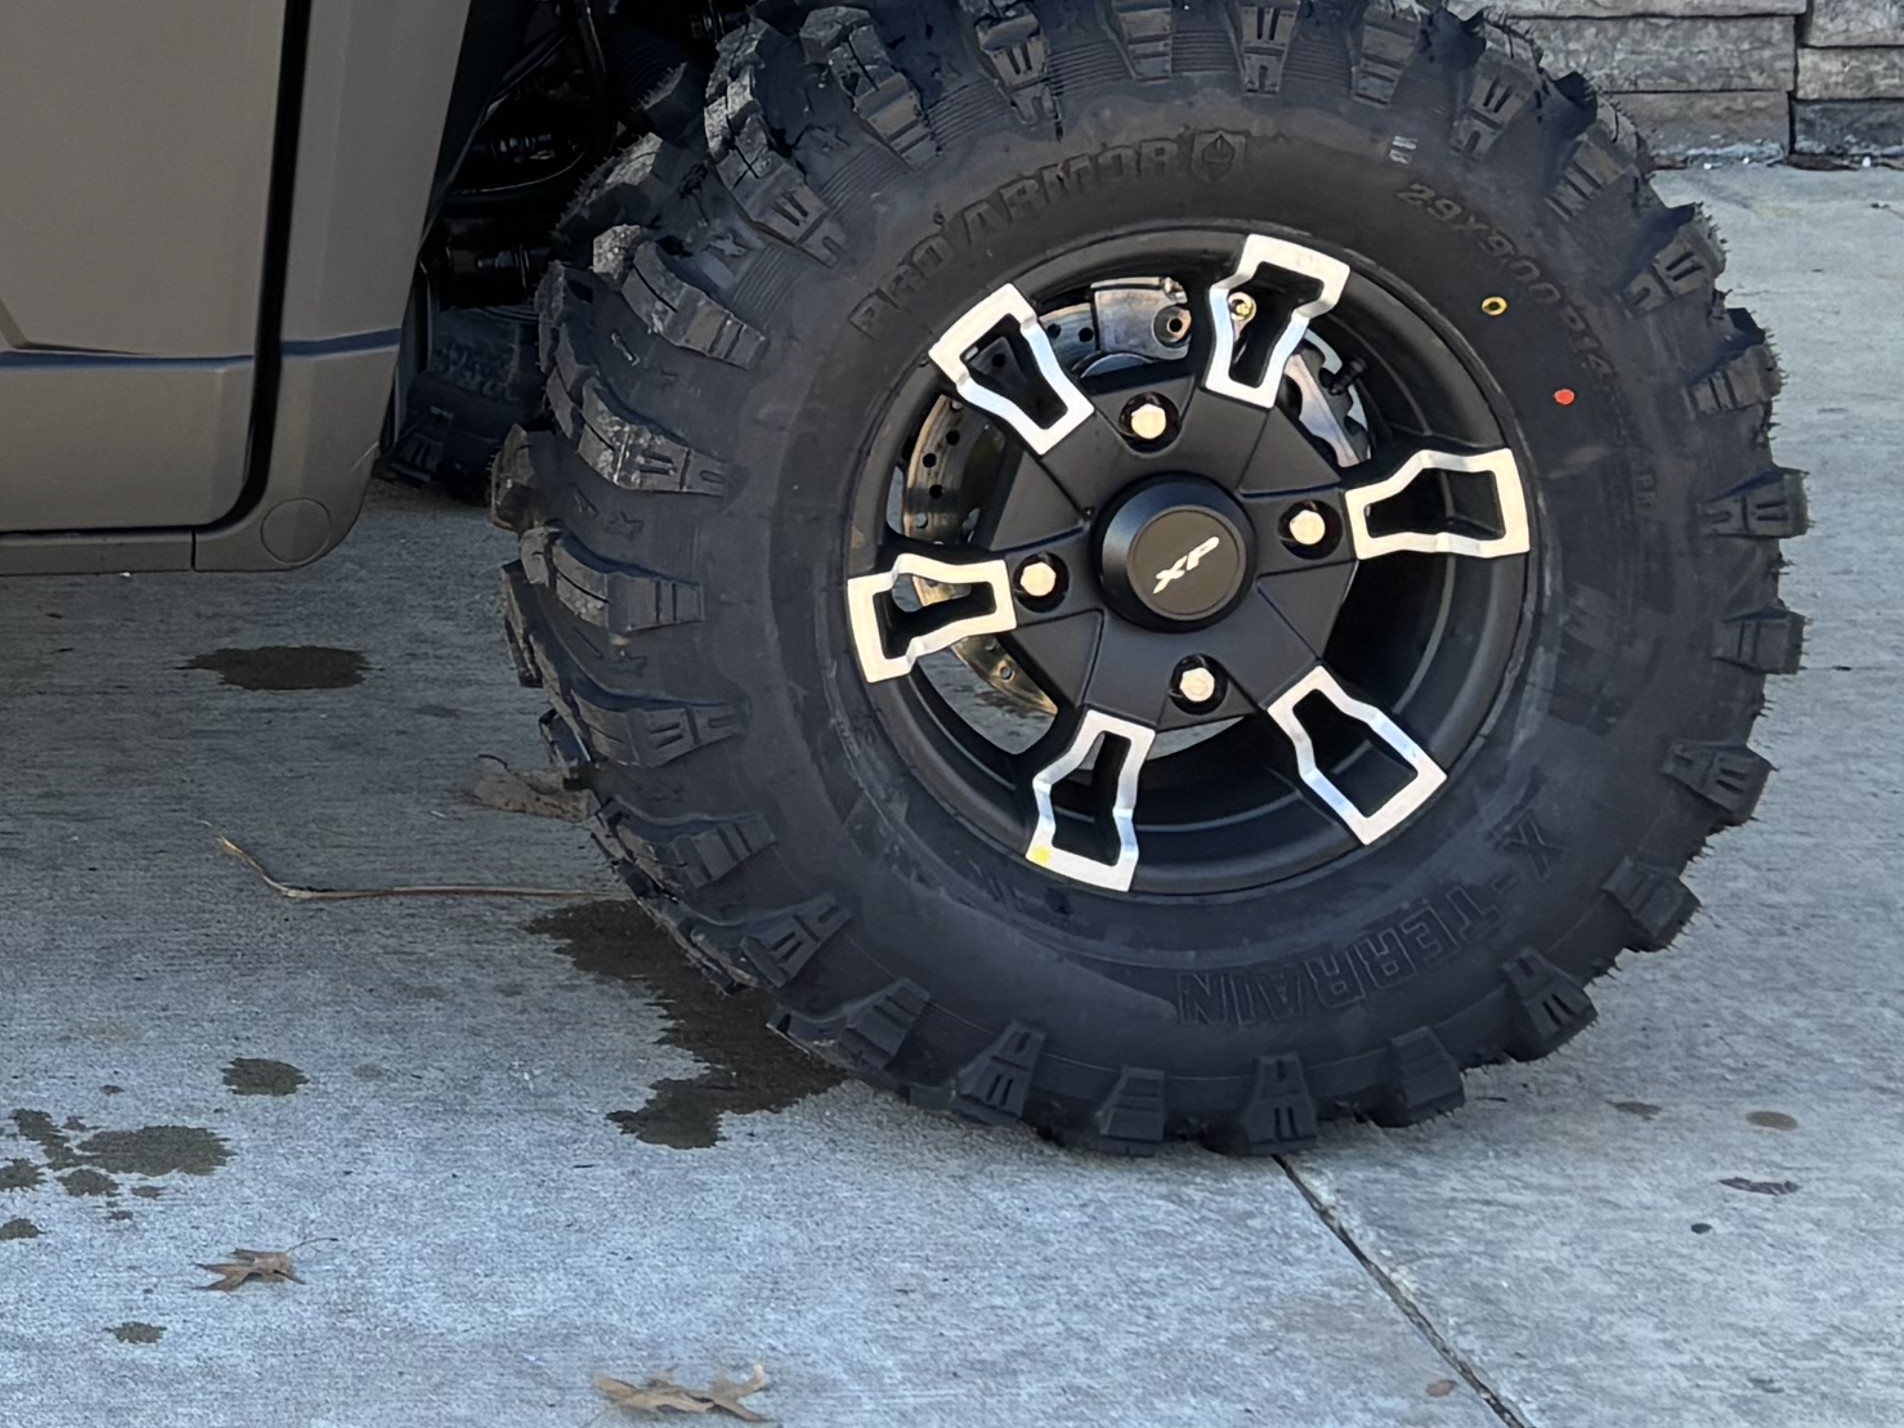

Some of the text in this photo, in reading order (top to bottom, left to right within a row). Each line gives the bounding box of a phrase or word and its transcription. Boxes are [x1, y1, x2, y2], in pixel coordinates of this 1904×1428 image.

[848, 137, 1187, 339] PRO ARMOR
[1152, 534, 1222, 595] XP
[1176, 811, 1566, 1025] X-TERRAIN
